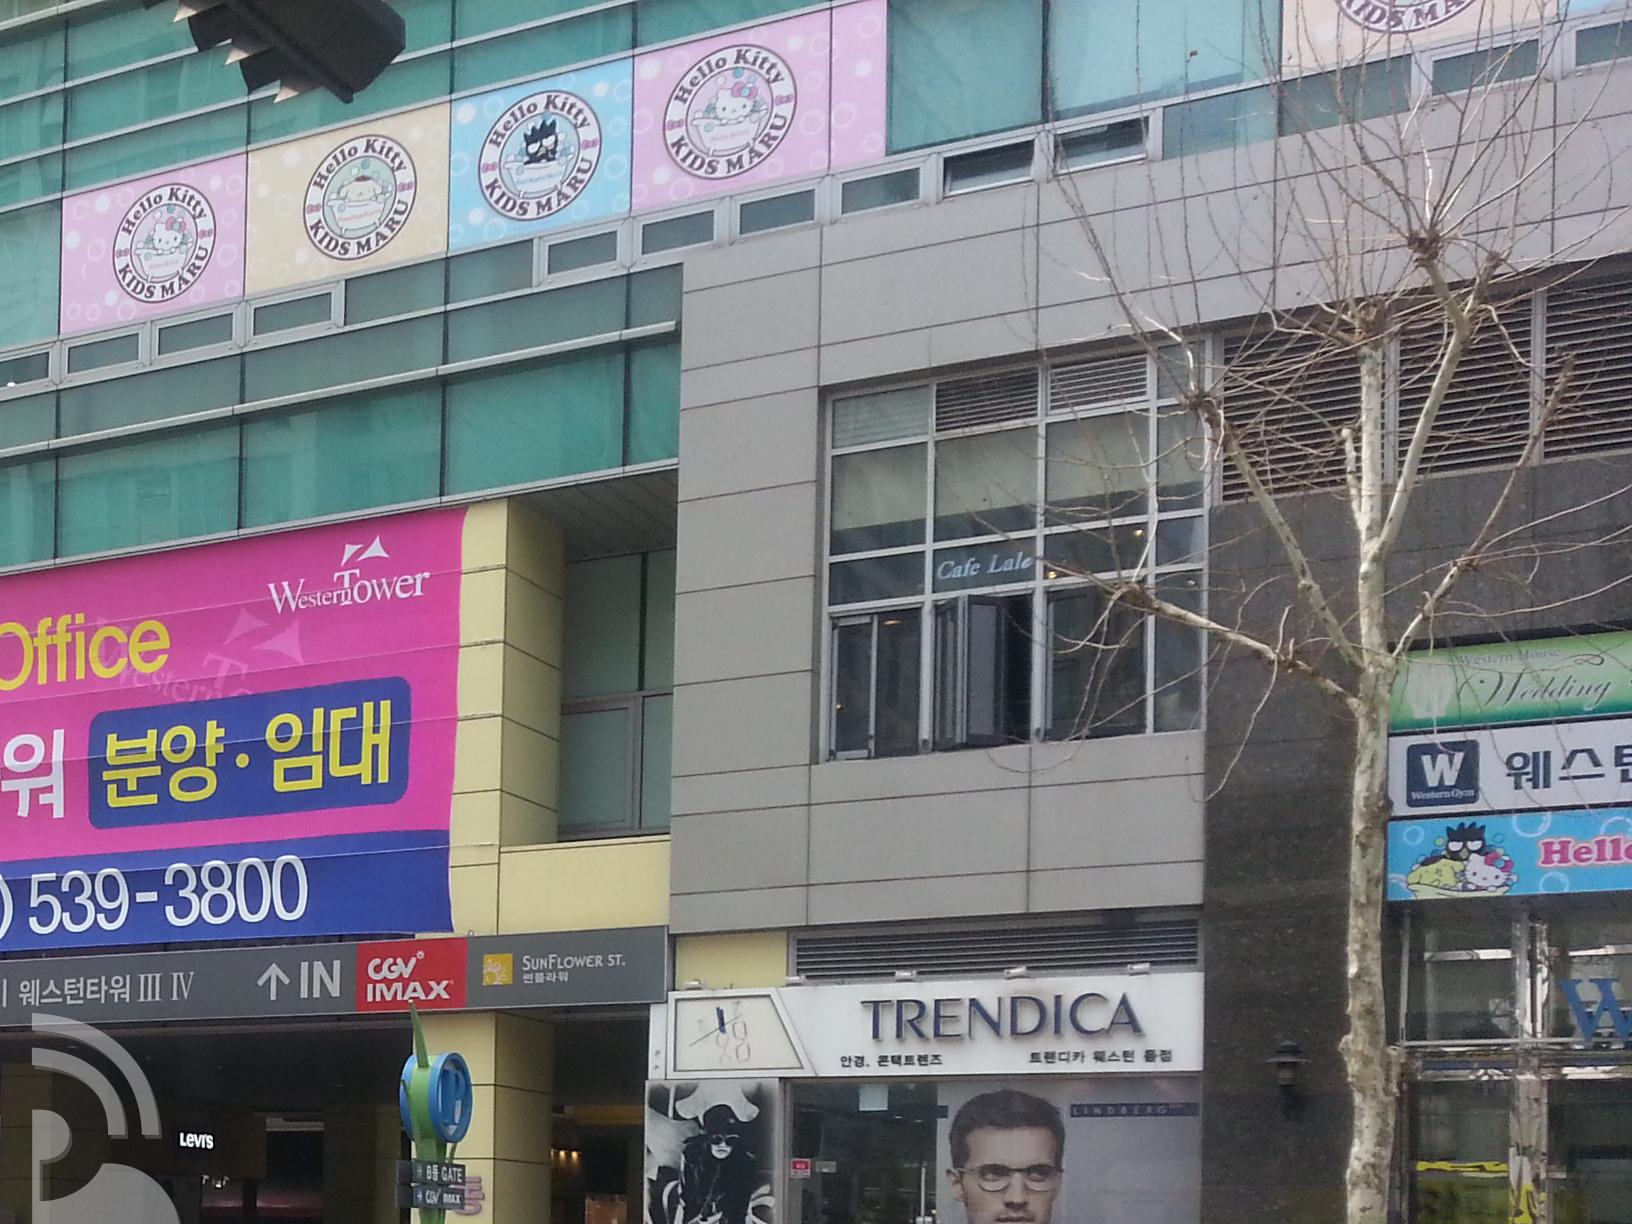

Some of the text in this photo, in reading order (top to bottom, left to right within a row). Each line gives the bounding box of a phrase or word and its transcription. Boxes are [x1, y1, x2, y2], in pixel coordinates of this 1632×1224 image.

[1345, 0, 1405, 28] IDS
[674, 49, 784, 105] Hello Kitty
[489, 94, 590, 149] Hello Kitty
[671, 114, 788, 175] KIDS MARU
[313, 138, 407, 190] Hello Kitty
[484, 156, 594, 217] KIDS MARU
[121, 187, 208, 236] Hello Kitty
[309, 199, 409, 256] KIDS MARU
[118, 245, 209, 300] KIDS MARU
[937, 558, 981, 581] Cafe
[1457, 660, 1613, 712] Wedding
[1422, 751, 1464, 787] W
[28, 854, 309, 935] 539-3800
[18, 974, 131, 1007] 웨스턴타워
[299, 959, 342, 1000] IN
[366, 979, 451, 1002] IMAX
[367, 955, 418, 981] CGV
[861, 991, 1146, 1042] TRENDICA
[1029, 1050, 1086, 1065] 트렌디카
[1093, 1048, 1136, 1064] 웨스턴
[441, 1166, 463, 1183] GATE
